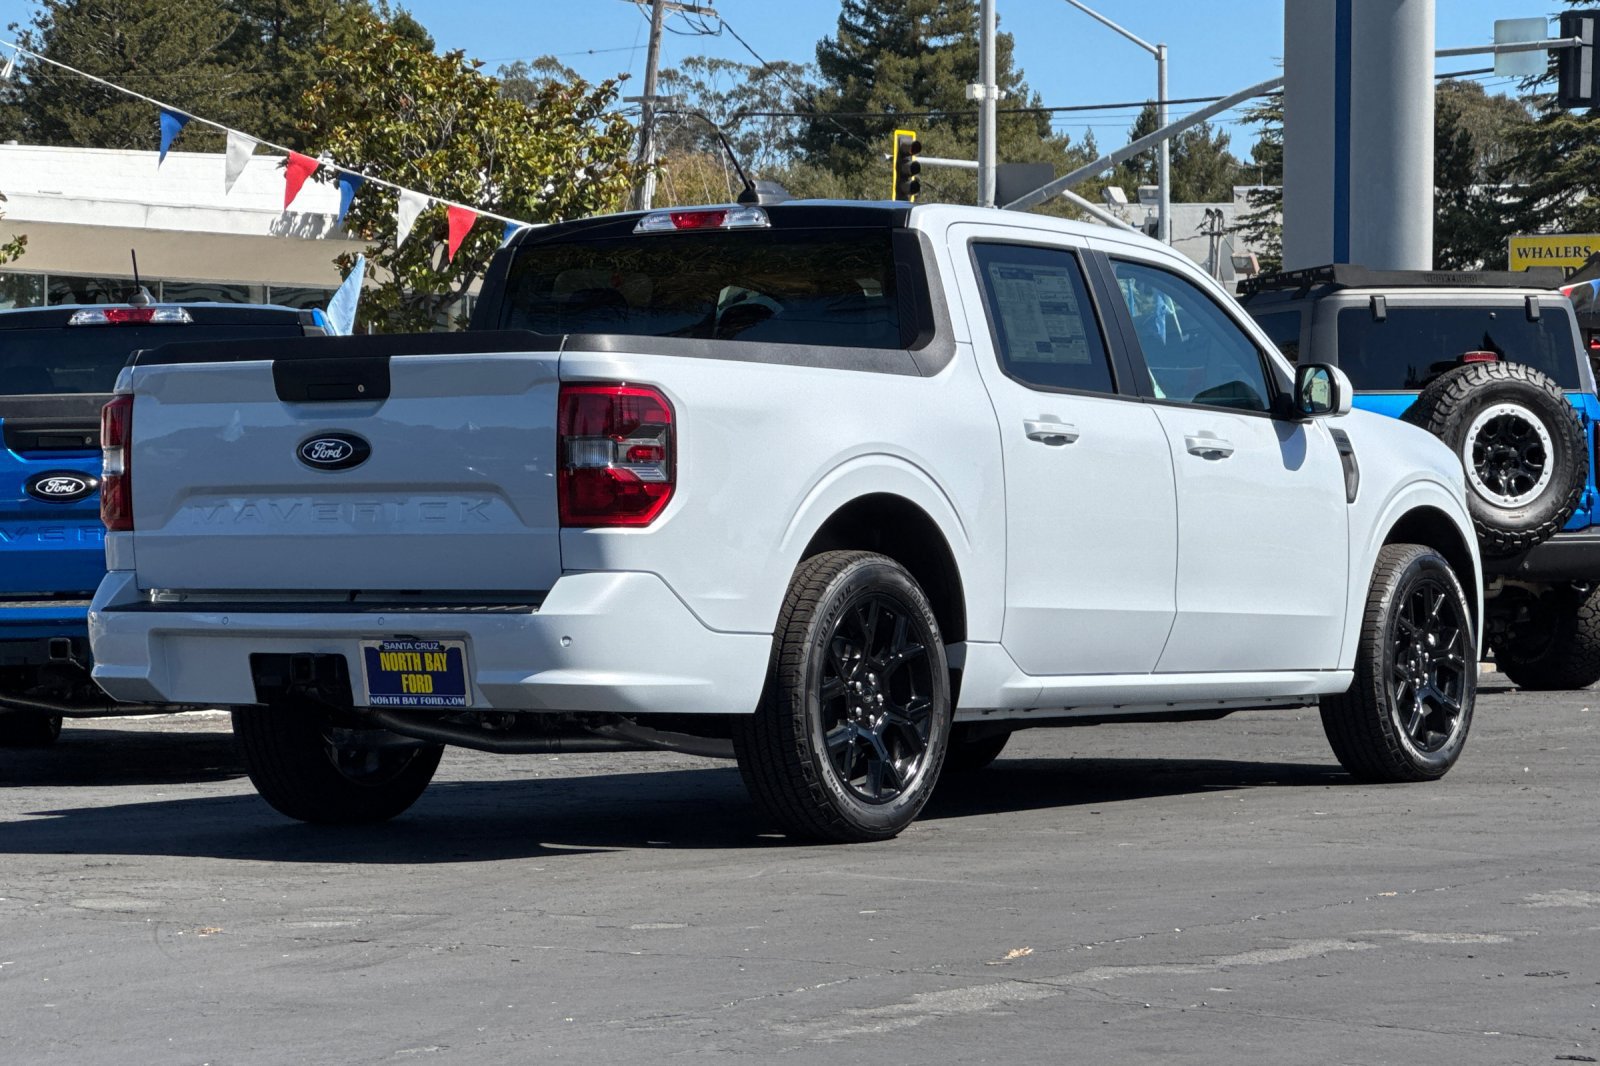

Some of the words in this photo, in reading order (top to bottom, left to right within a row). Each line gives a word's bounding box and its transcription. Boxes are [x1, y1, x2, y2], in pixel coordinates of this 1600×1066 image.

[1517, 246, 1592, 259] WHALERS
[311, 441, 343, 459] Ford
[45, 479, 77, 493] Ford
[192, 502, 492, 523] MAVERICK
[384, 642, 412, 650] SANTA
[414, 642, 439, 650] CRUZ
[380, 652, 422, 671] NORTH
[424, 652, 447, 672] BAY
[401, 674, 433, 693] FORD
[370, 696, 400, 705] NORTH
[402, 696, 418, 705] BAY
